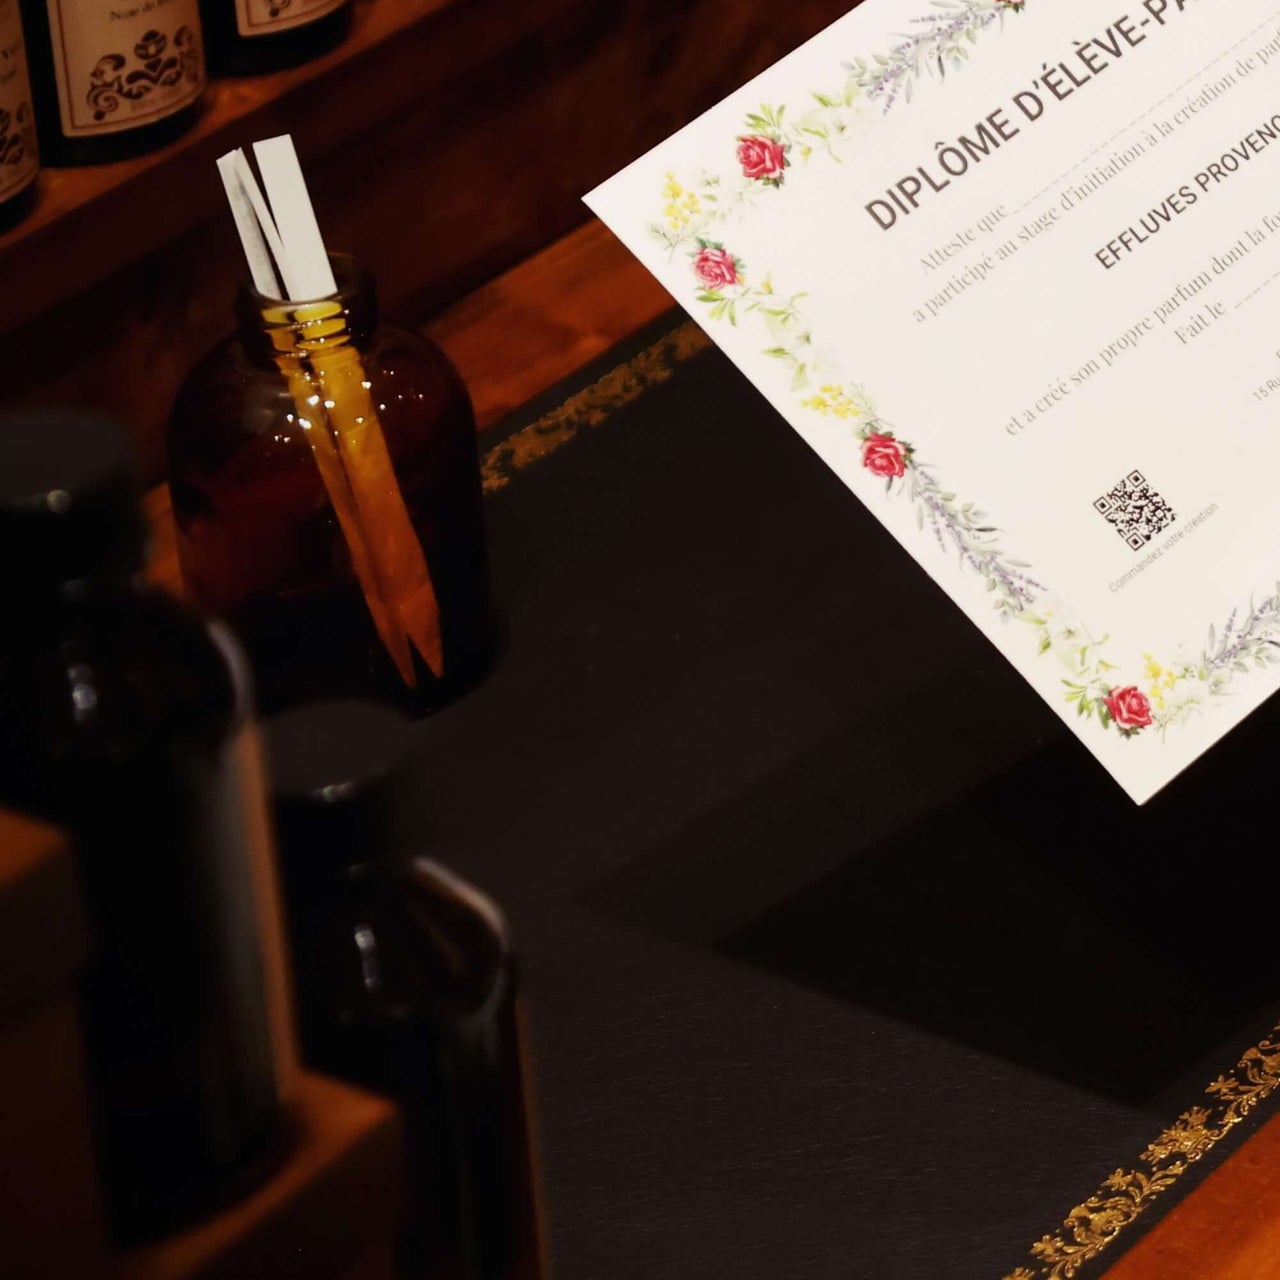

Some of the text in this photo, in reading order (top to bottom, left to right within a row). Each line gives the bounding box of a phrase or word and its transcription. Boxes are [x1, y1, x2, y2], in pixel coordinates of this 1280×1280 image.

[863, 107, 1021, 231] DIPLÔME
[912, 309, 926, 323] a
[923, 251, 995, 317] participé
[994, 239, 1018, 261] au
[1016, 207, 1059, 242] stage
[1141, 130, 1158, 147] à
[1152, 120, 1175, 138] la
[1173, 73, 1237, 125] création
[1235, 57, 1255, 77] de
[920, 205, 1007, 270] Atteste que
[1093, 184, 1198, 270] EFFLUVES
[1005, 416, 1025, 436] et
[1022, 408, 1037, 423] a
[1034, 376, 1070, 413] créé
[1069, 359, 1101, 384] son
[1098, 316, 1153, 366] propre
[1152, 271, 1212, 324] parfum
[1211, 239, 1249, 275] dont
[1243, 229, 1267, 246] la
[1173, 301, 1225, 345] Fait le
[1252, 385, 1269, 401] 15
[1108, 546, 1164, 593] Commandez
[1162, 530, 1185, 550] votre
